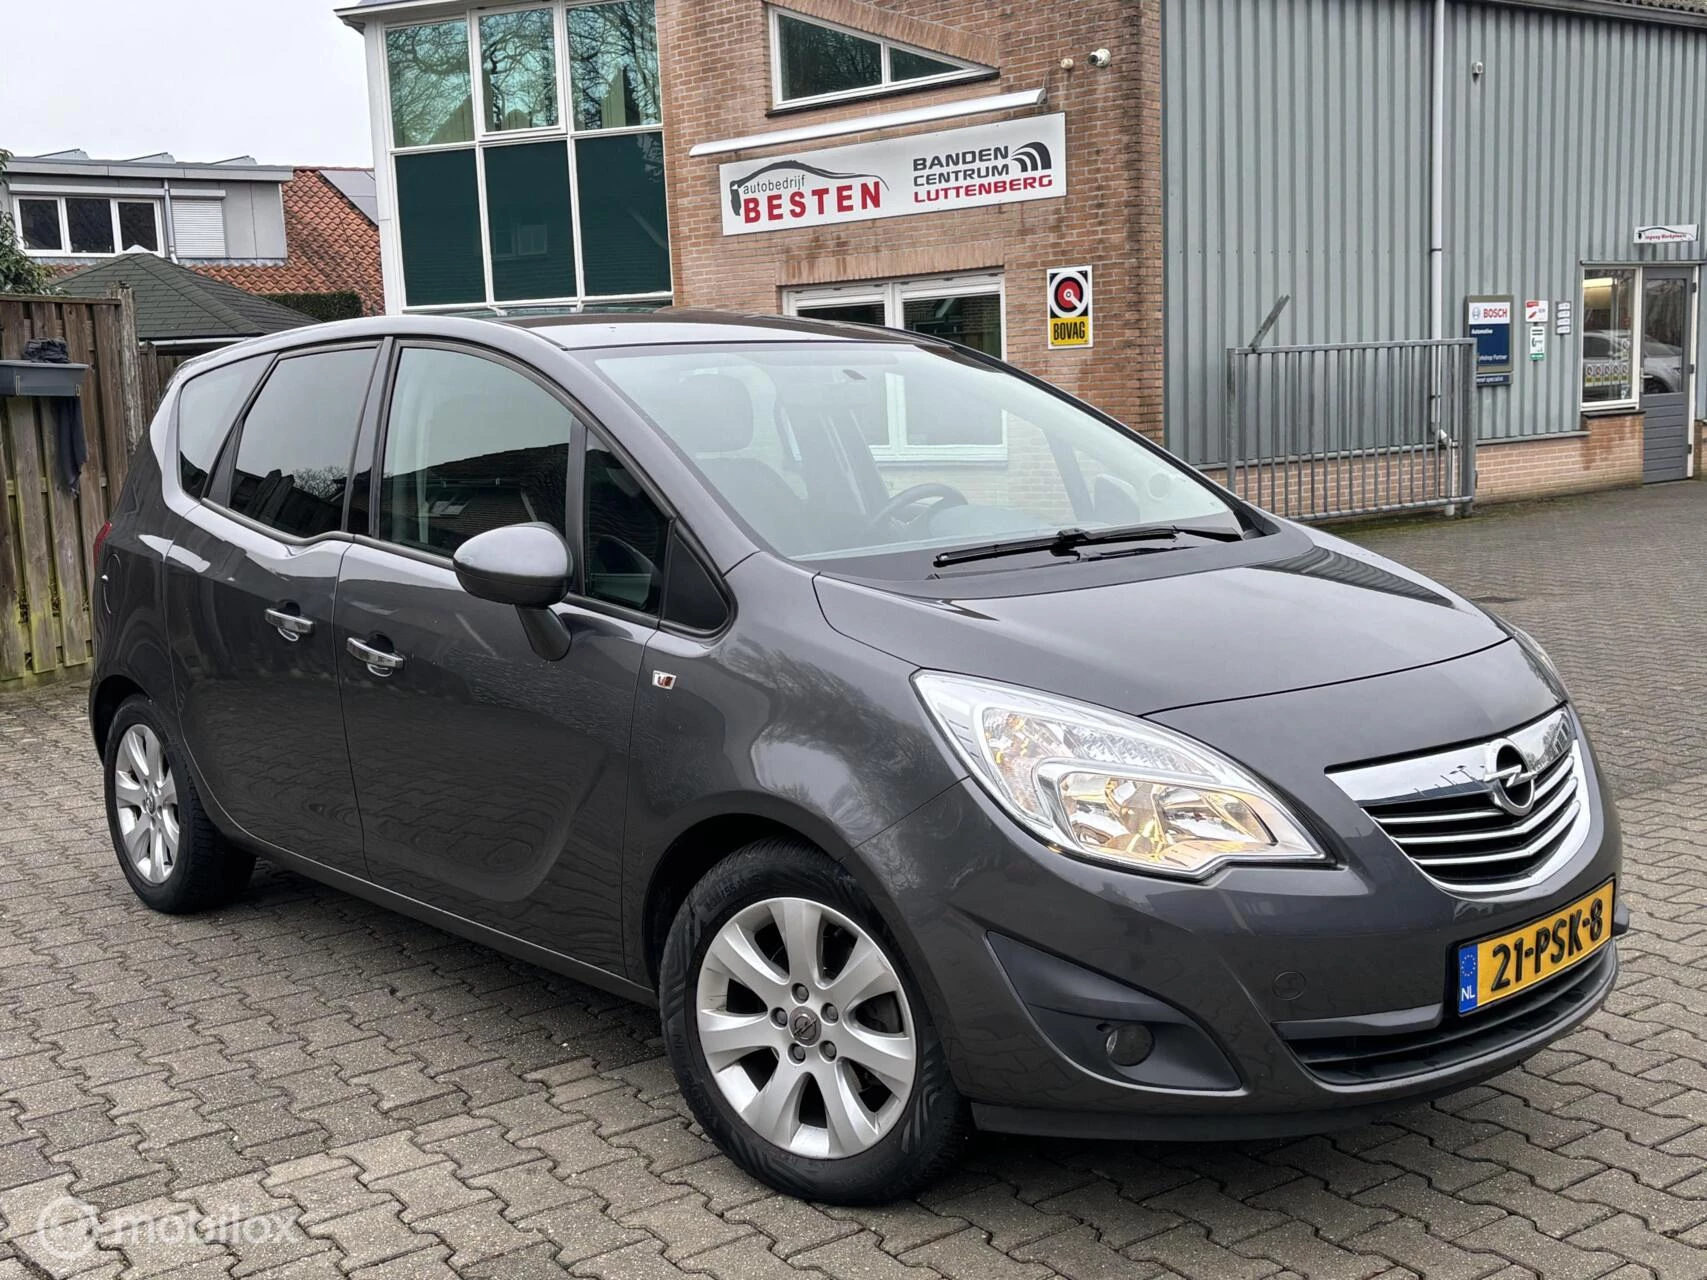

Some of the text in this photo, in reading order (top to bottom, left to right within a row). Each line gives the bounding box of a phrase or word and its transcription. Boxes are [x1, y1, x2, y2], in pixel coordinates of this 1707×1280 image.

[913, 145, 1010, 172] BANDEN
[743, 174, 806, 195] autobedrijf
[913, 163, 1010, 187] CENTRUM
[914, 174, 1054, 203] LUTTENBERG
[743, 180, 882, 224] BESTEN
[1483, 308, 1507, 319] BOSCH
[1053, 321, 1086, 341] BOVAG
[1490, 898, 1604, 992] 21-PSK-8
[1461, 985, 1476, 1002] NL
